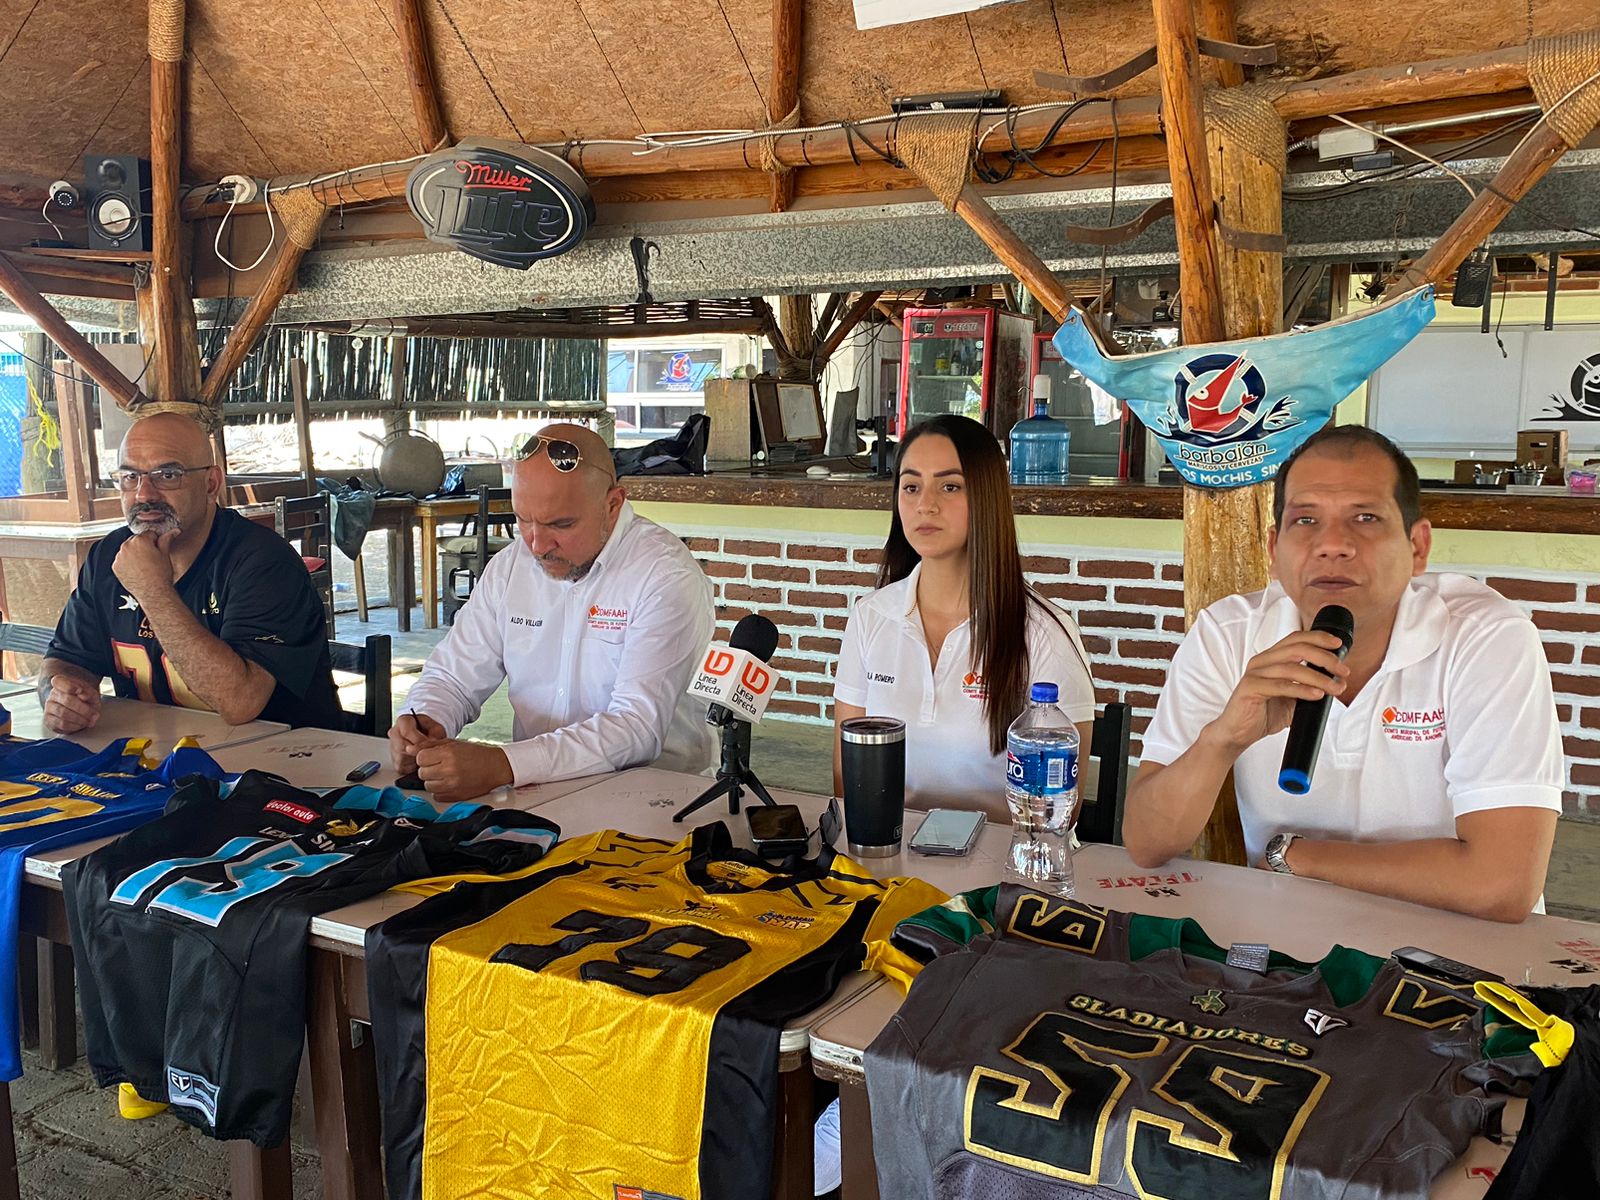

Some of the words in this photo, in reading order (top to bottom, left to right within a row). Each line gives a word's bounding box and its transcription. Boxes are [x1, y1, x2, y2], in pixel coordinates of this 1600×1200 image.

[455, 160, 533, 187] Miller
[436, 185, 564, 245] Lite
[1179, 441, 1268, 463] barbaján
[1187, 460, 1219, 471] MARISCOS
[1229, 456, 1264, 470] CERVEZAS
[510, 616, 524, 625] ALDO
[874, 673, 896, 685] ROMERO
[693, 681, 721, 696] Directa
[731, 693, 757, 716] Directa
[1395, 707, 1445, 724] COMFAAH
[293, 808, 315, 822] auto
[1096, 871, 1200, 889] TECATE
[1068, 995, 1310, 1057] GLADIADORES
[964, 1011, 1331, 1200] 59
